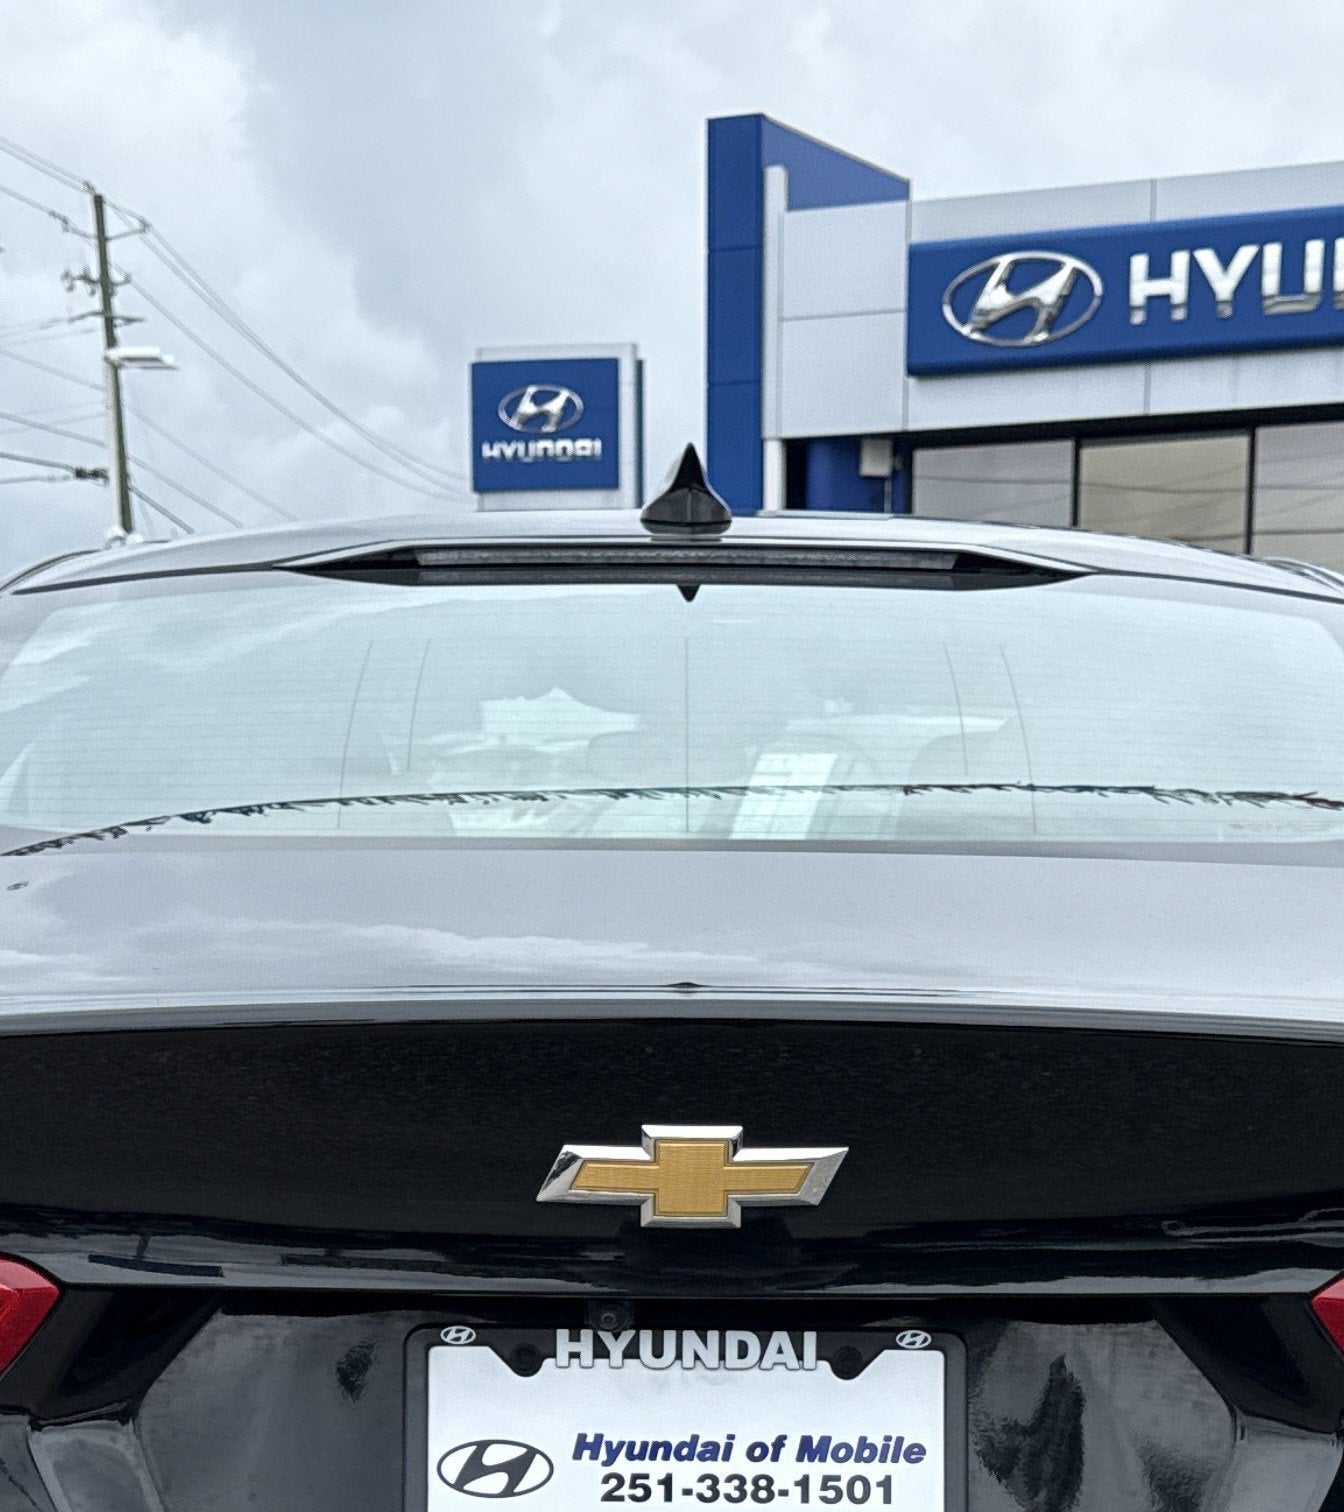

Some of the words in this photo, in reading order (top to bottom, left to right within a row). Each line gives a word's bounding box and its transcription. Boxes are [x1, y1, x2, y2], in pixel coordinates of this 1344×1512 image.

[481, 438, 603, 463] HYUNDAI
[555, 1328, 818, 1371] HYUNDAI
[572, 1433, 735, 1467] Hyundai
[746, 1434, 787, 1463] of
[795, 1435, 927, 1464] Mobile
[600, 1471, 893, 1505] 251-338-1501
